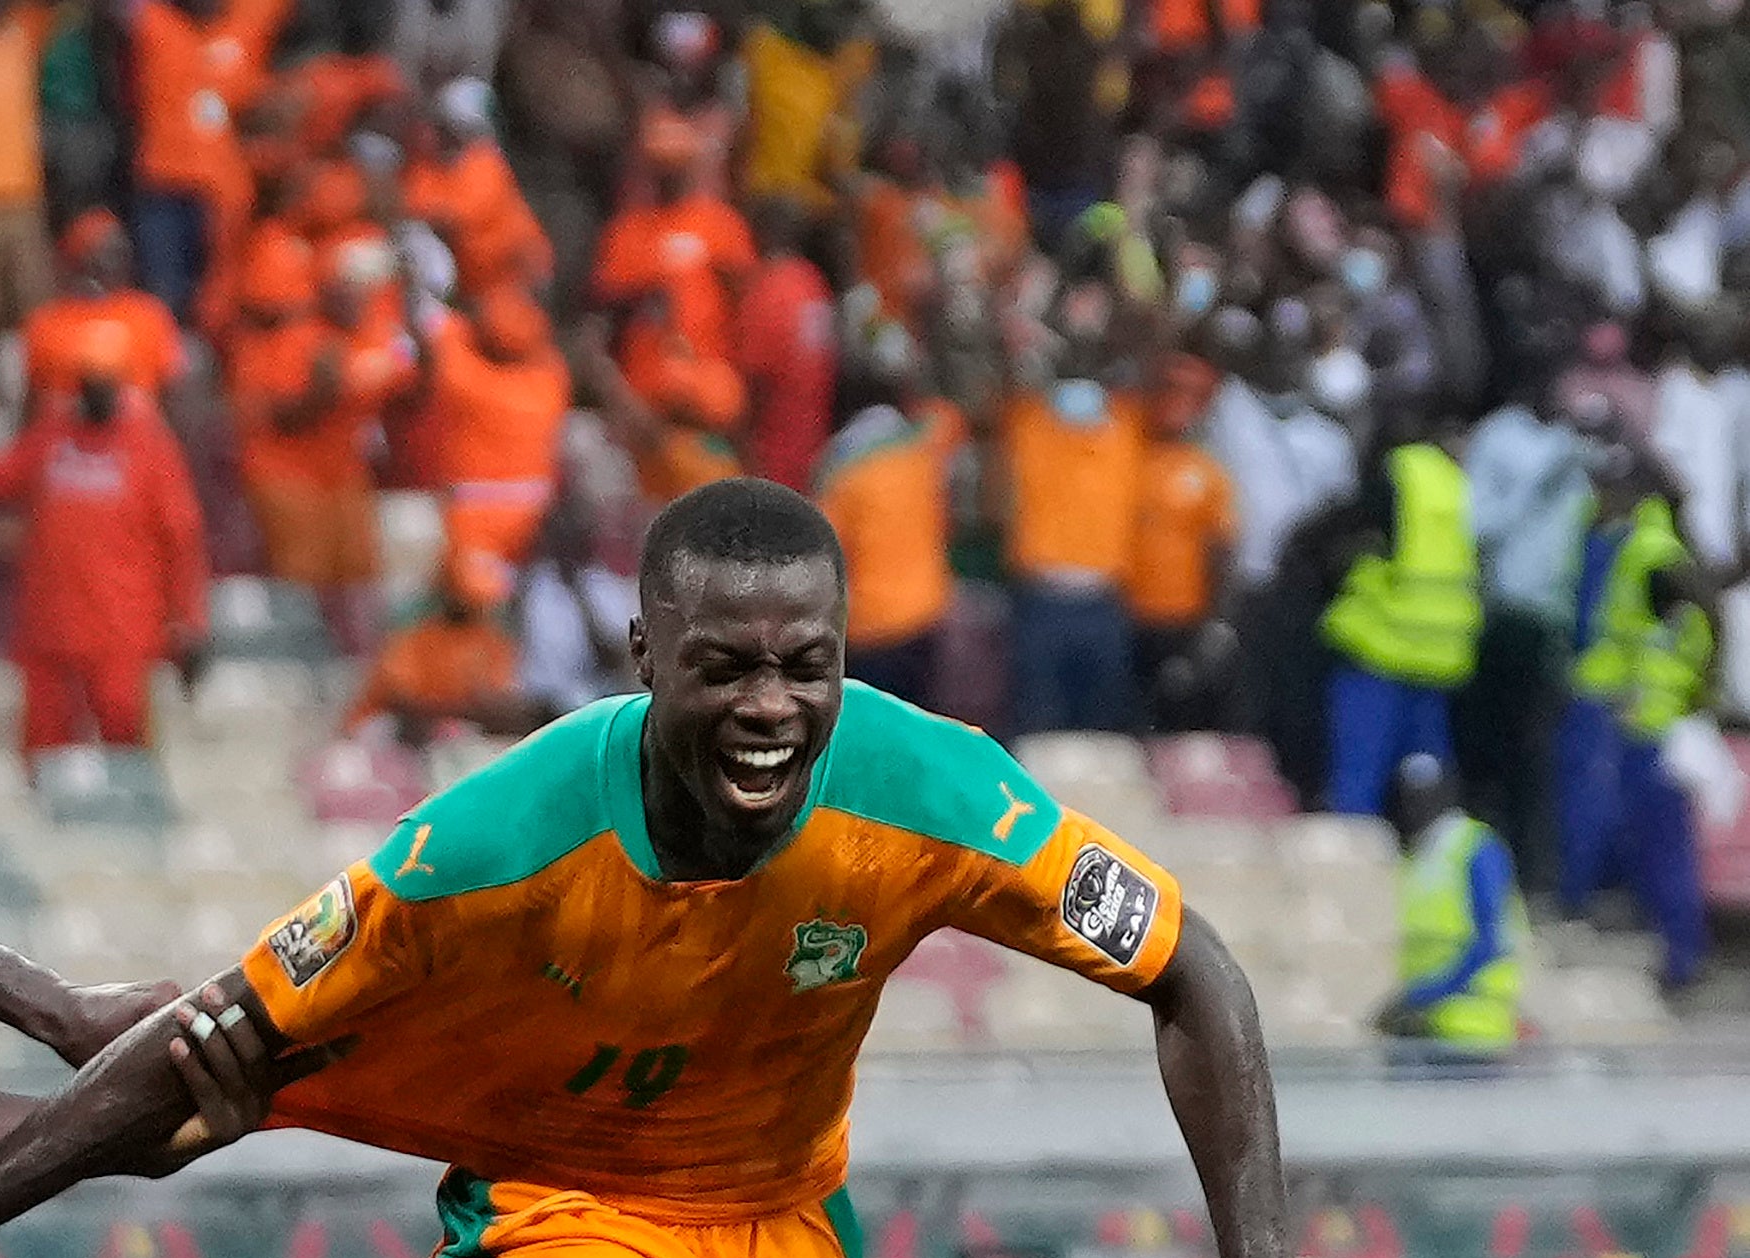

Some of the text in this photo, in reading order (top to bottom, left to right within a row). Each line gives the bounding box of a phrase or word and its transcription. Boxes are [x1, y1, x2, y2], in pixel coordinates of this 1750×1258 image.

[1081, 861, 1122, 939] Celebrate
[1120, 893, 1145, 950] CAF
[564, 1042, 689, 1110] 19
